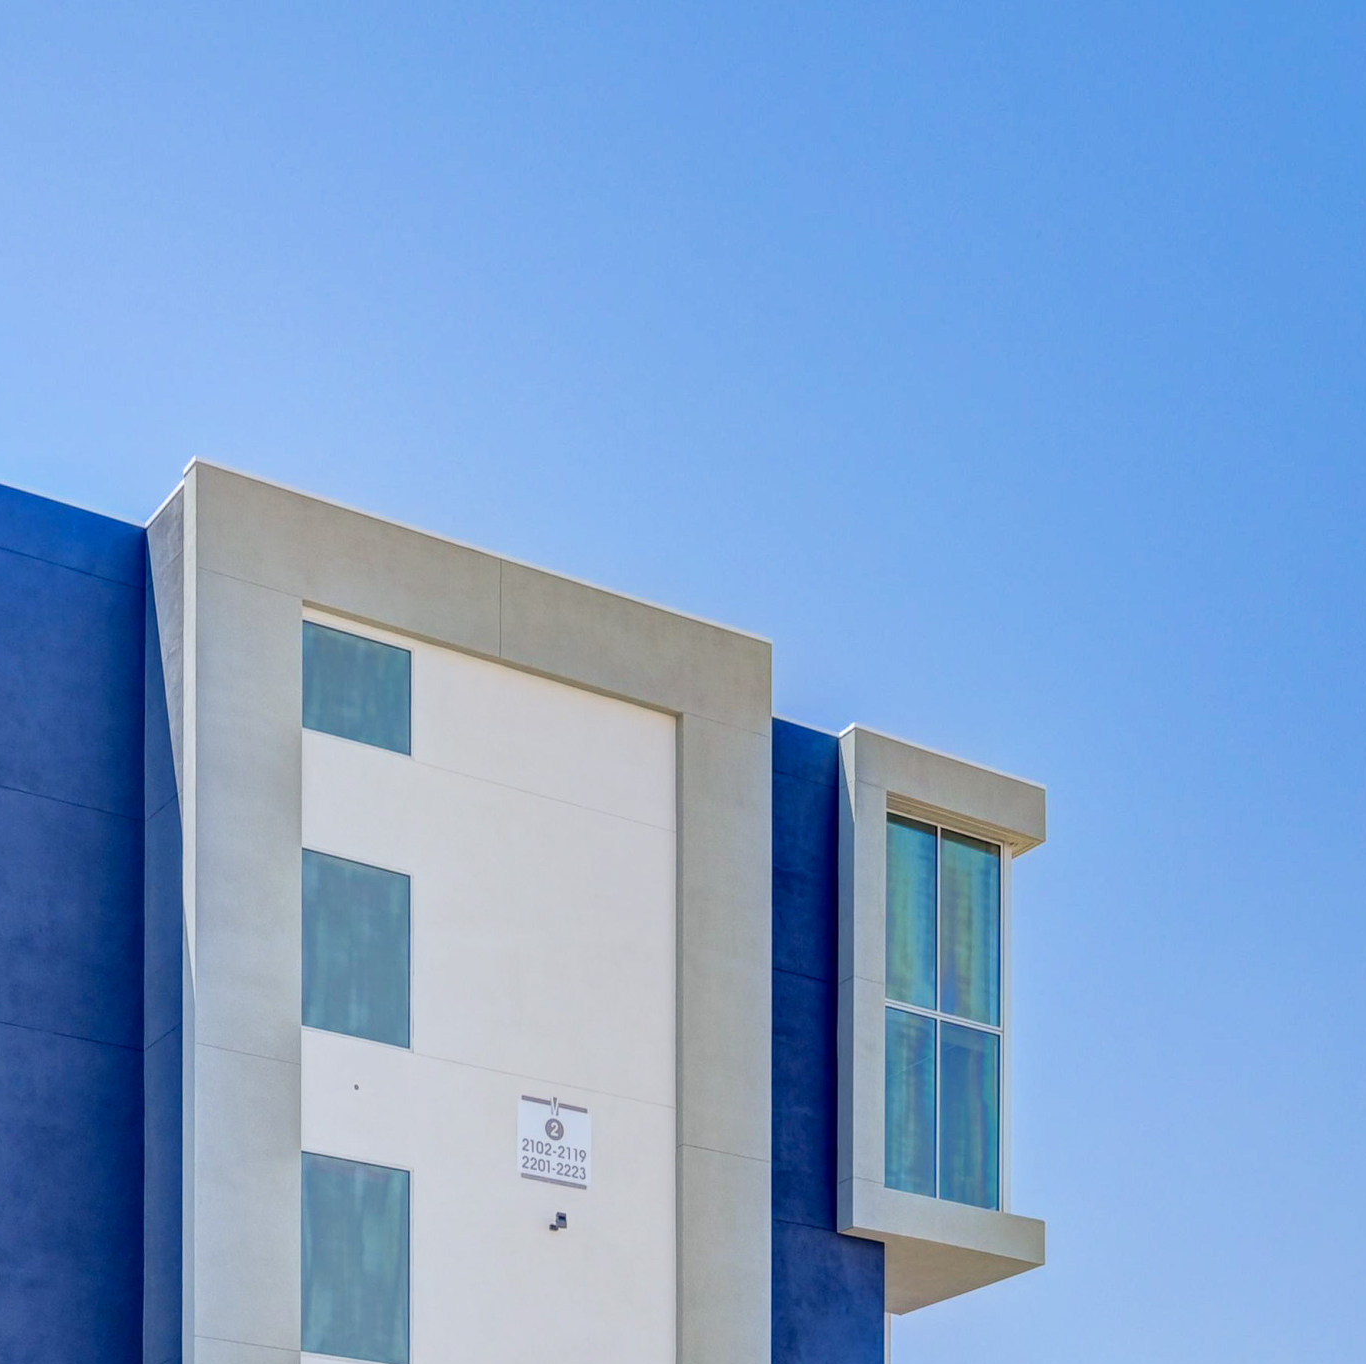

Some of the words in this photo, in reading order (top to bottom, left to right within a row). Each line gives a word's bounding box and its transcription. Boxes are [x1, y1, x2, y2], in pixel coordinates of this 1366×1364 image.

[550, 1122, 559, 1137] 2
[522, 1138, 586, 1162] 2102-2119
[522, 1155, 586, 1180] 2201-2223
